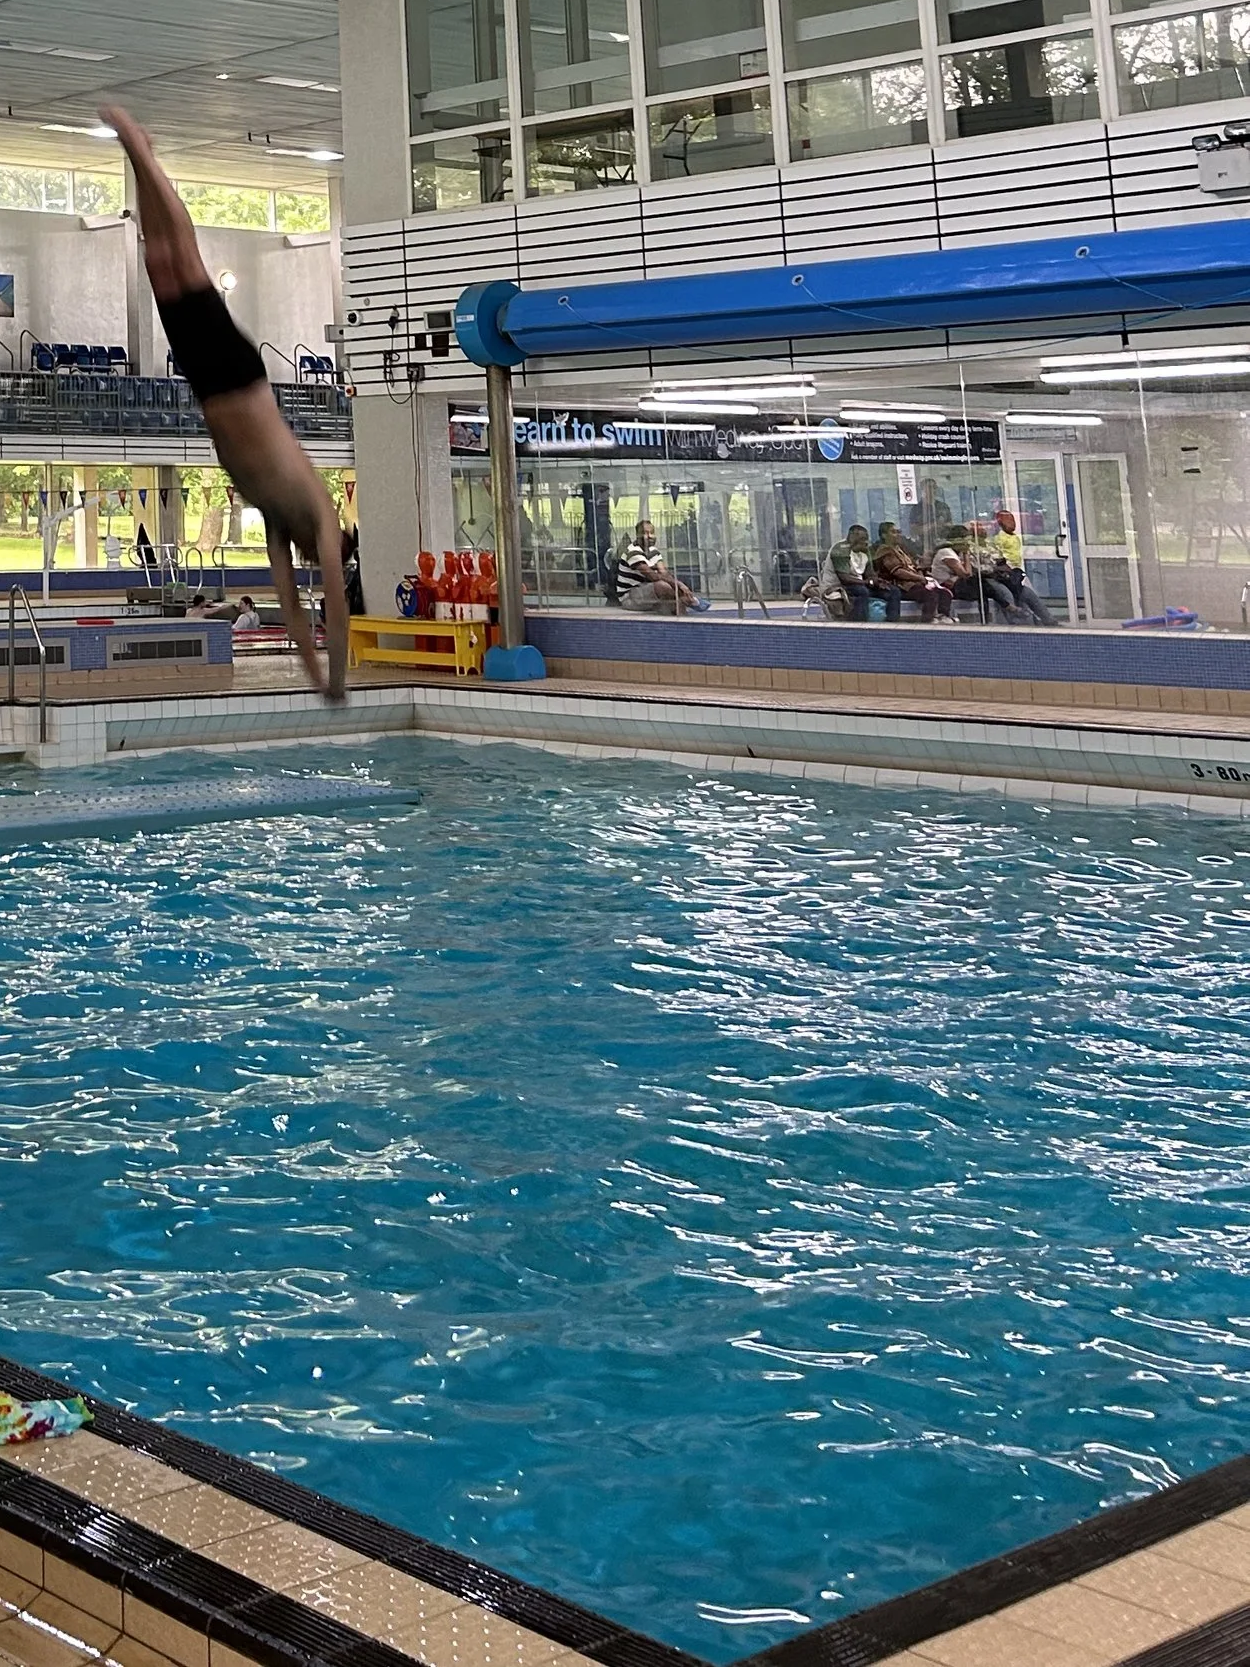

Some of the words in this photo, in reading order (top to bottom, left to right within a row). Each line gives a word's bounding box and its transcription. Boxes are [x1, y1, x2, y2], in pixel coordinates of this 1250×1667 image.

[514, 419, 566, 444] earn
[572, 417, 595, 444] to
[601, 421, 662, 446] swim
